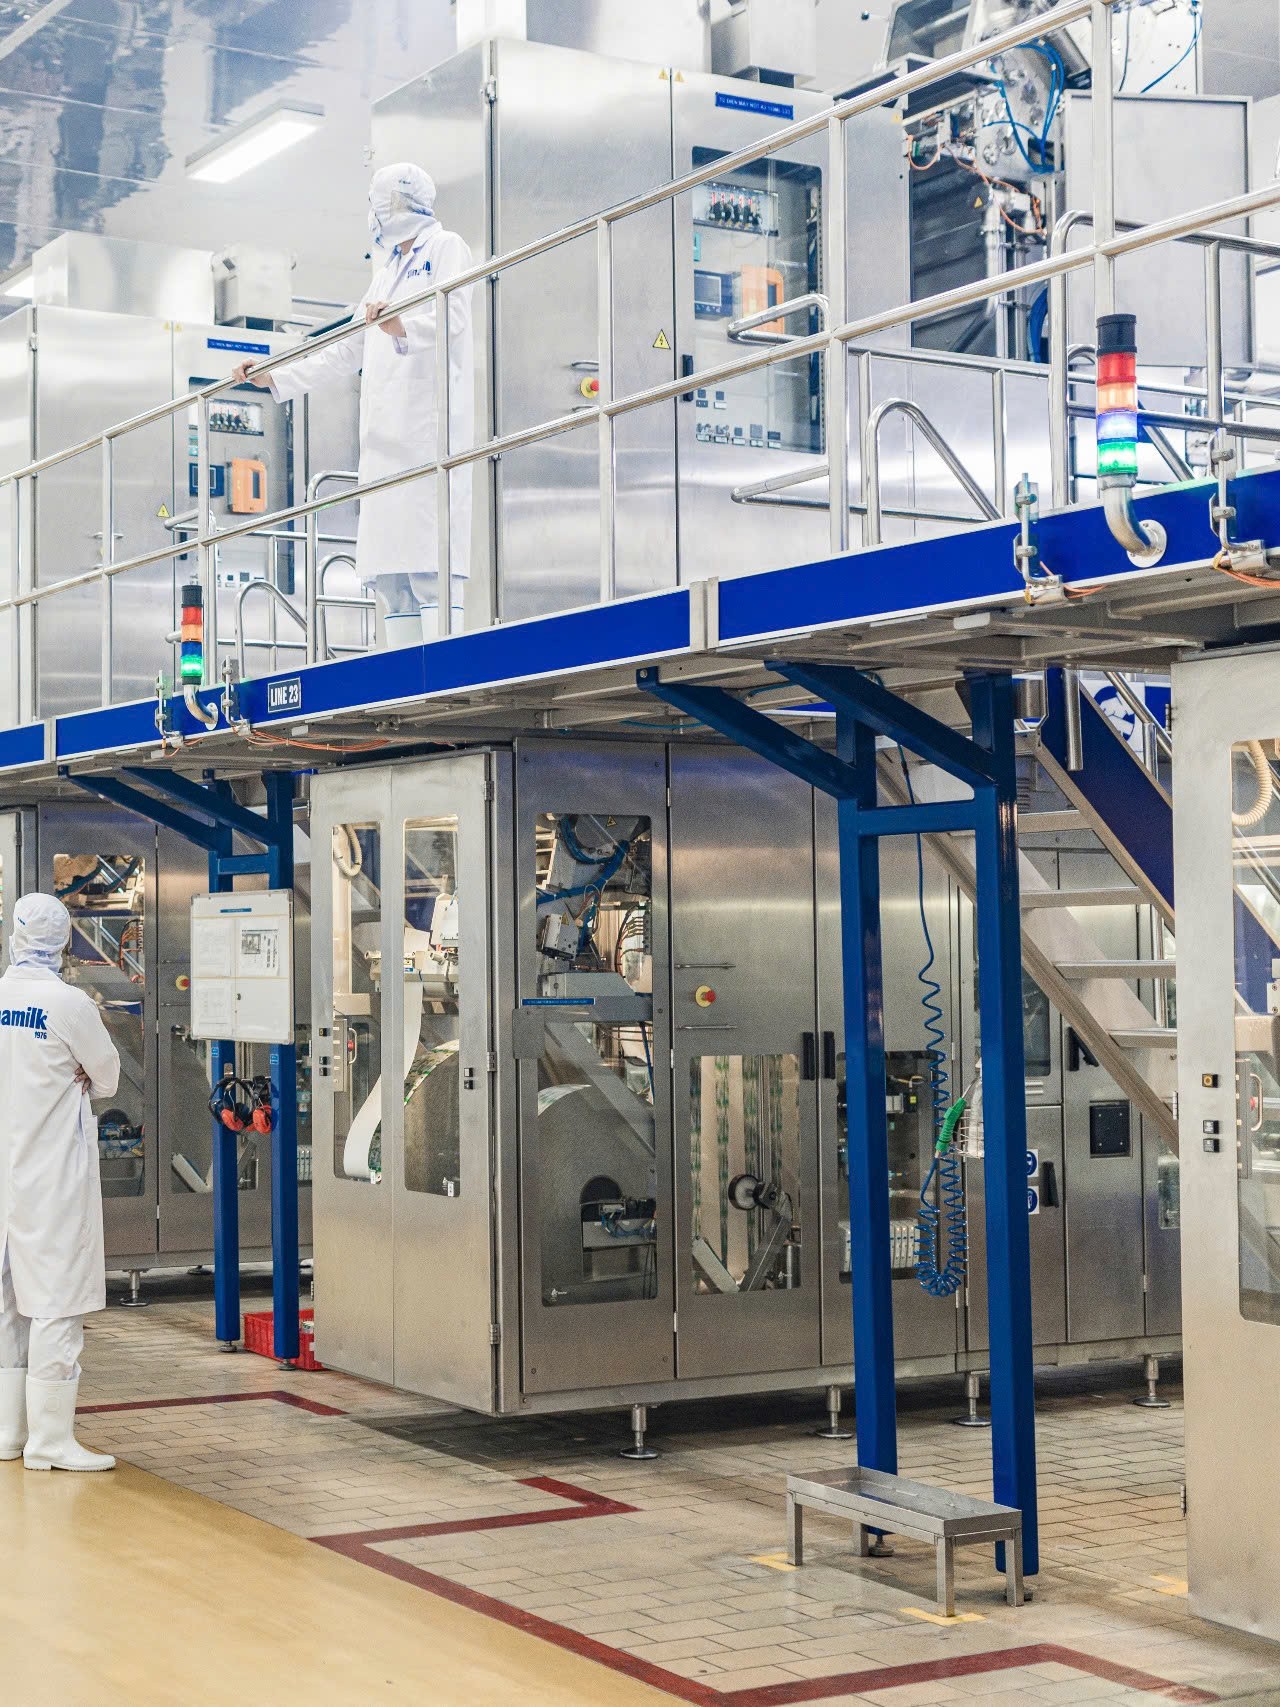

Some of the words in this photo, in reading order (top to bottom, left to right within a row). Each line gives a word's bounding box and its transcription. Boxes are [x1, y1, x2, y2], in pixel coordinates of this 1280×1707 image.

[270, 686, 288, 707] LINE
[288, 684, 299, 703] 23
[34, 1031, 48, 1040] 1976
